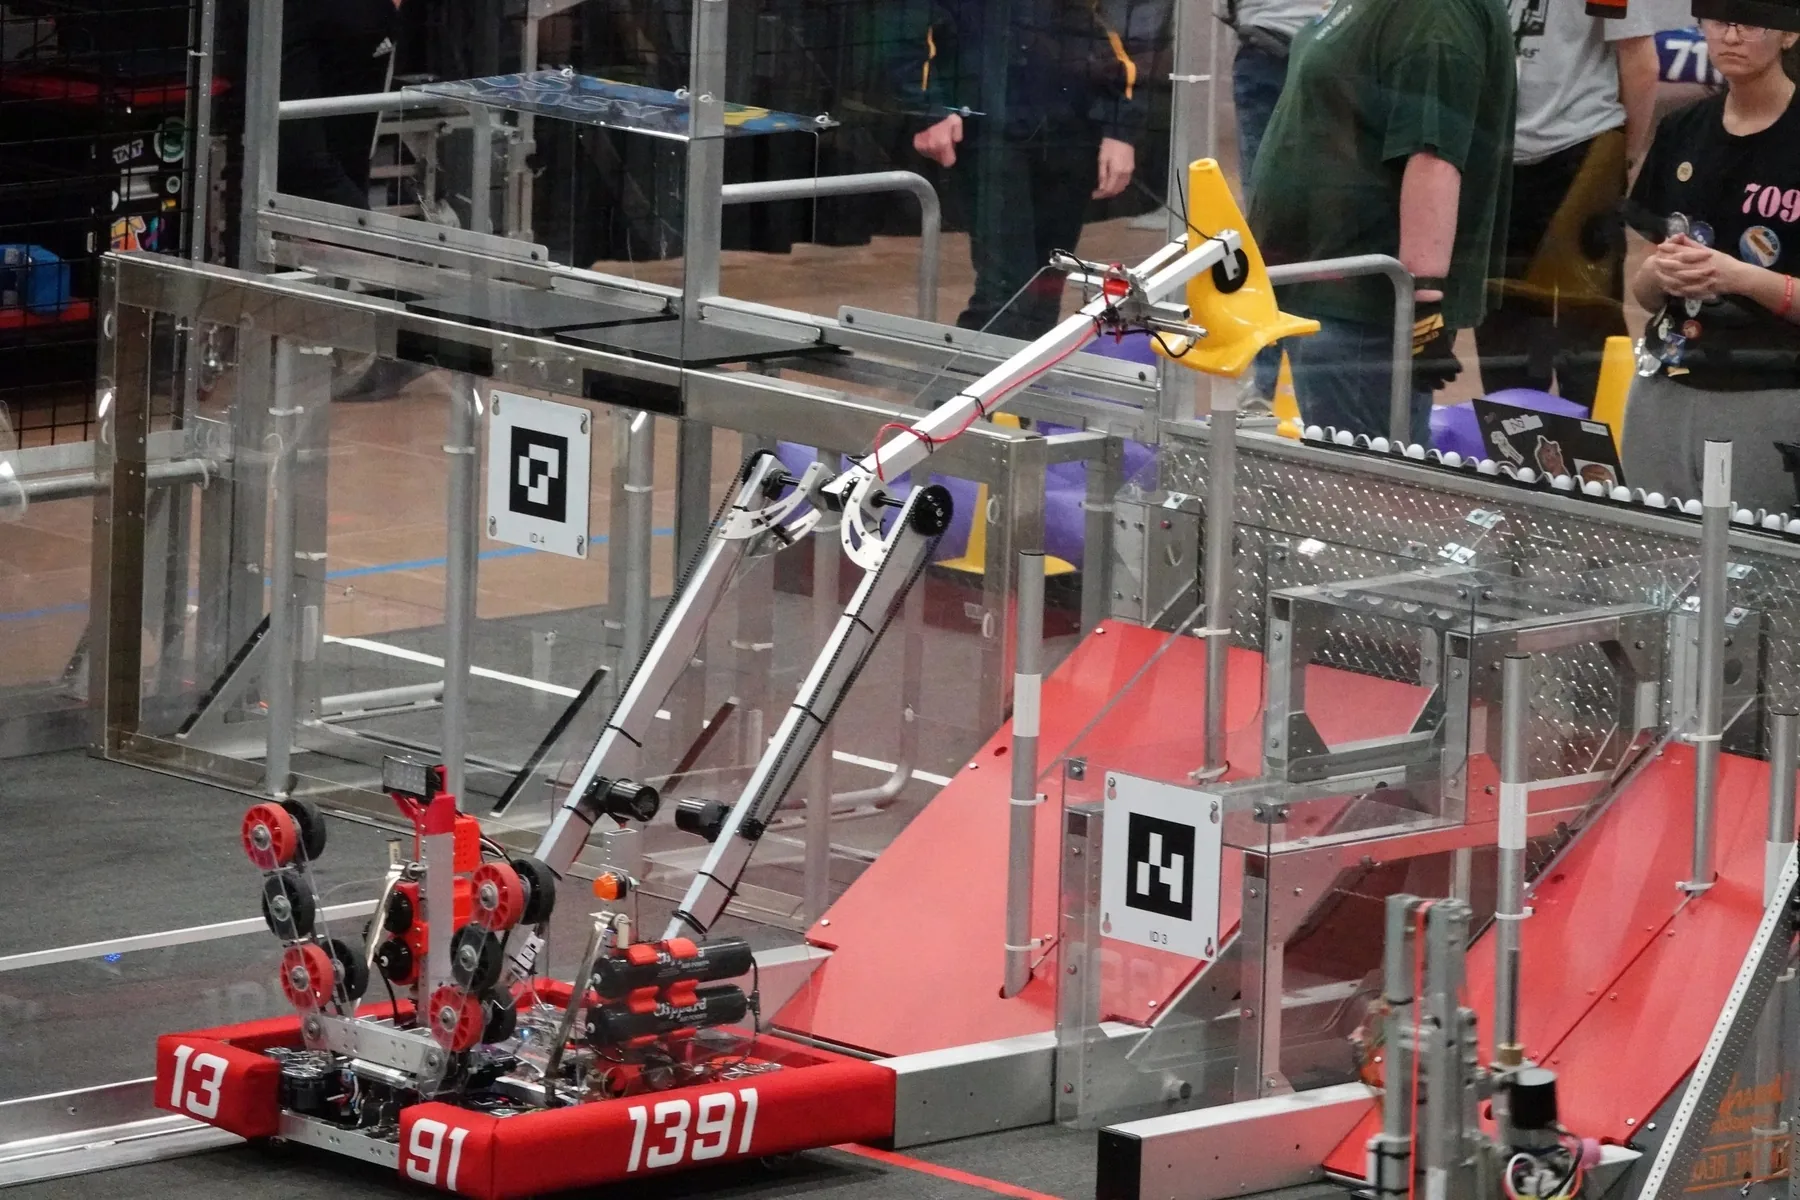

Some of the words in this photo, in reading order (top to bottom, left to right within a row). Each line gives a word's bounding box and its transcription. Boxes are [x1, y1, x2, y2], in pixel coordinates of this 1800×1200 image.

[1665, 39, 1723, 84] 71
[1741, 182, 1800, 223] 709
[1149, 930, 1160, 943] ID
[1161, 933, 1169, 945] 3
[170, 1044, 229, 1120] 13
[406, 1117, 471, 1192] 91
[626, 1088, 759, 1173] 1391
